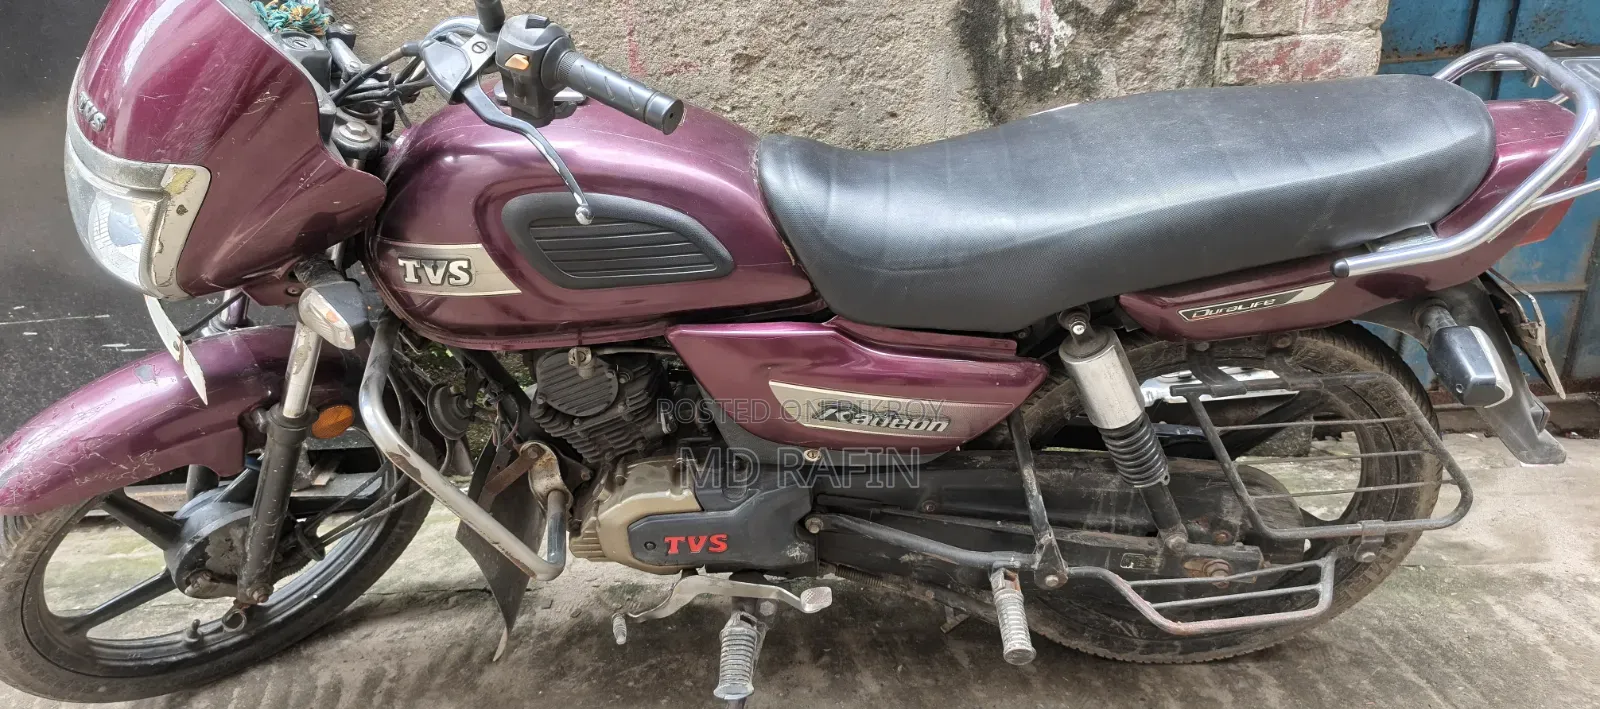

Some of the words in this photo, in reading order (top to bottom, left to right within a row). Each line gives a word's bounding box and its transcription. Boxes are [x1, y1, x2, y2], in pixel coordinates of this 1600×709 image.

[79, 91, 107, 132] TVS
[397, 258, 471, 285] TVS
[814, 401, 950, 432] Radeon
[663, 532, 729, 555] TVS
